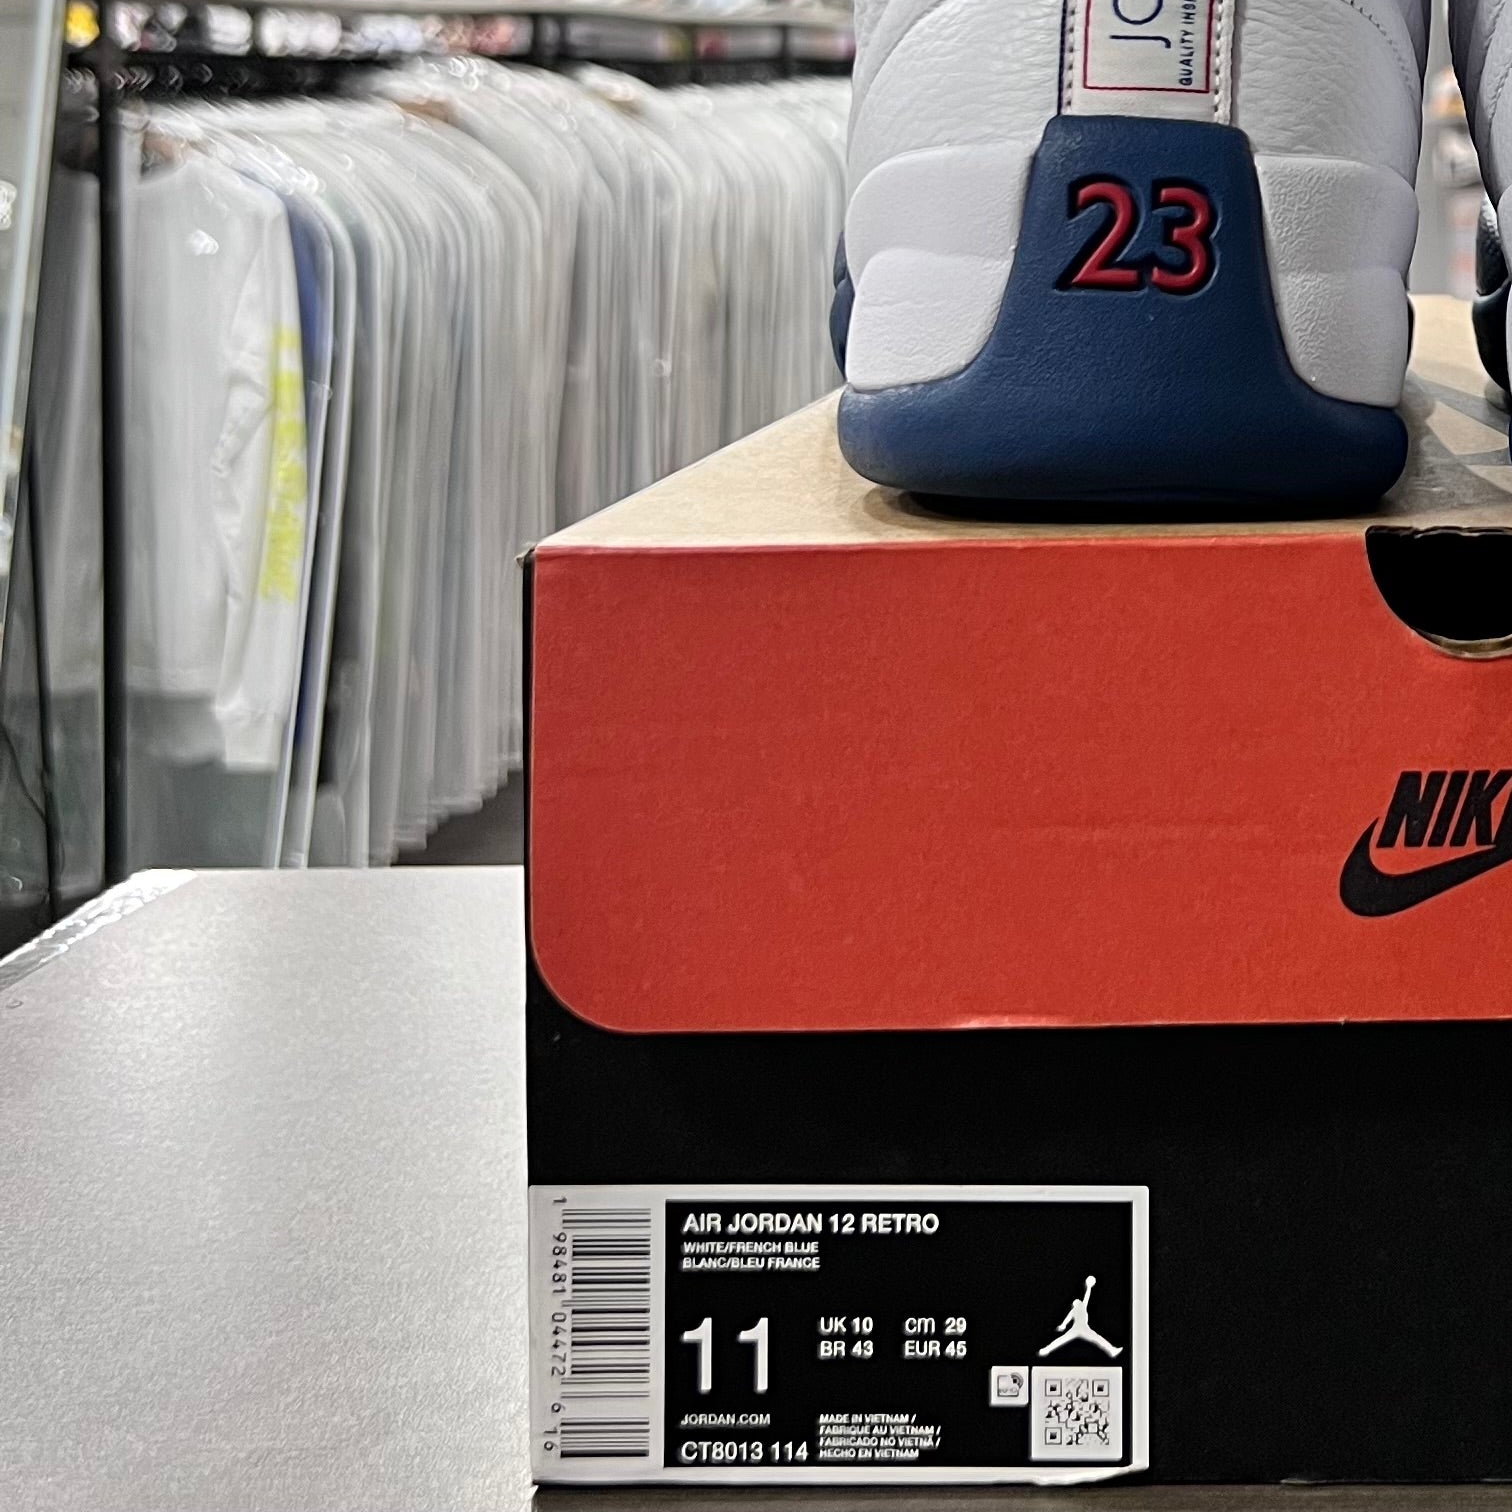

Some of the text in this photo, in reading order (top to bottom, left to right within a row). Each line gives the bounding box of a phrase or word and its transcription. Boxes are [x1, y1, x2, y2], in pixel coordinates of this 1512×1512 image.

[1178, 30, 1195, 86] QUALITY
[1061, 174, 1216, 295] 23
[683, 1213, 939, 1234] AIR JORDAN 12 RETRO
[683, 1241, 819, 1254] WHITE/FRENCH BLUE
[552, 1232, 568, 1294] 98481
[682, 1257, 821, 1270] BLANC/BLEU FRANCE
[819, 1316, 874, 1335] UK 10
[944, 1316, 967, 1335] 29
[551, 1312, 567, 1376] 04472
[819, 1340, 874, 1359] BR 43
[904, 1340, 967, 1359] EUR 45
[682, 1317, 768, 1394] 11
[680, 1413, 771, 1426] JORDAN.COM
[819, 1413, 849, 1424] MADE
[852, 1413, 863, 1424] IN
[864, 1413, 909, 1424] VIETNAM
[819, 1425, 870, 1436] FABRIQUE
[872, 1425, 887, 1436] AU
[889, 1425, 934, 1436] VIETNAM
[819, 1436, 878, 1447] FABRICADO
[880, 1436, 896, 1447] NO
[681, 1441, 809, 1462] CT8013 114
[819, 1448, 920, 1459] HECHO EN VIETNAM
